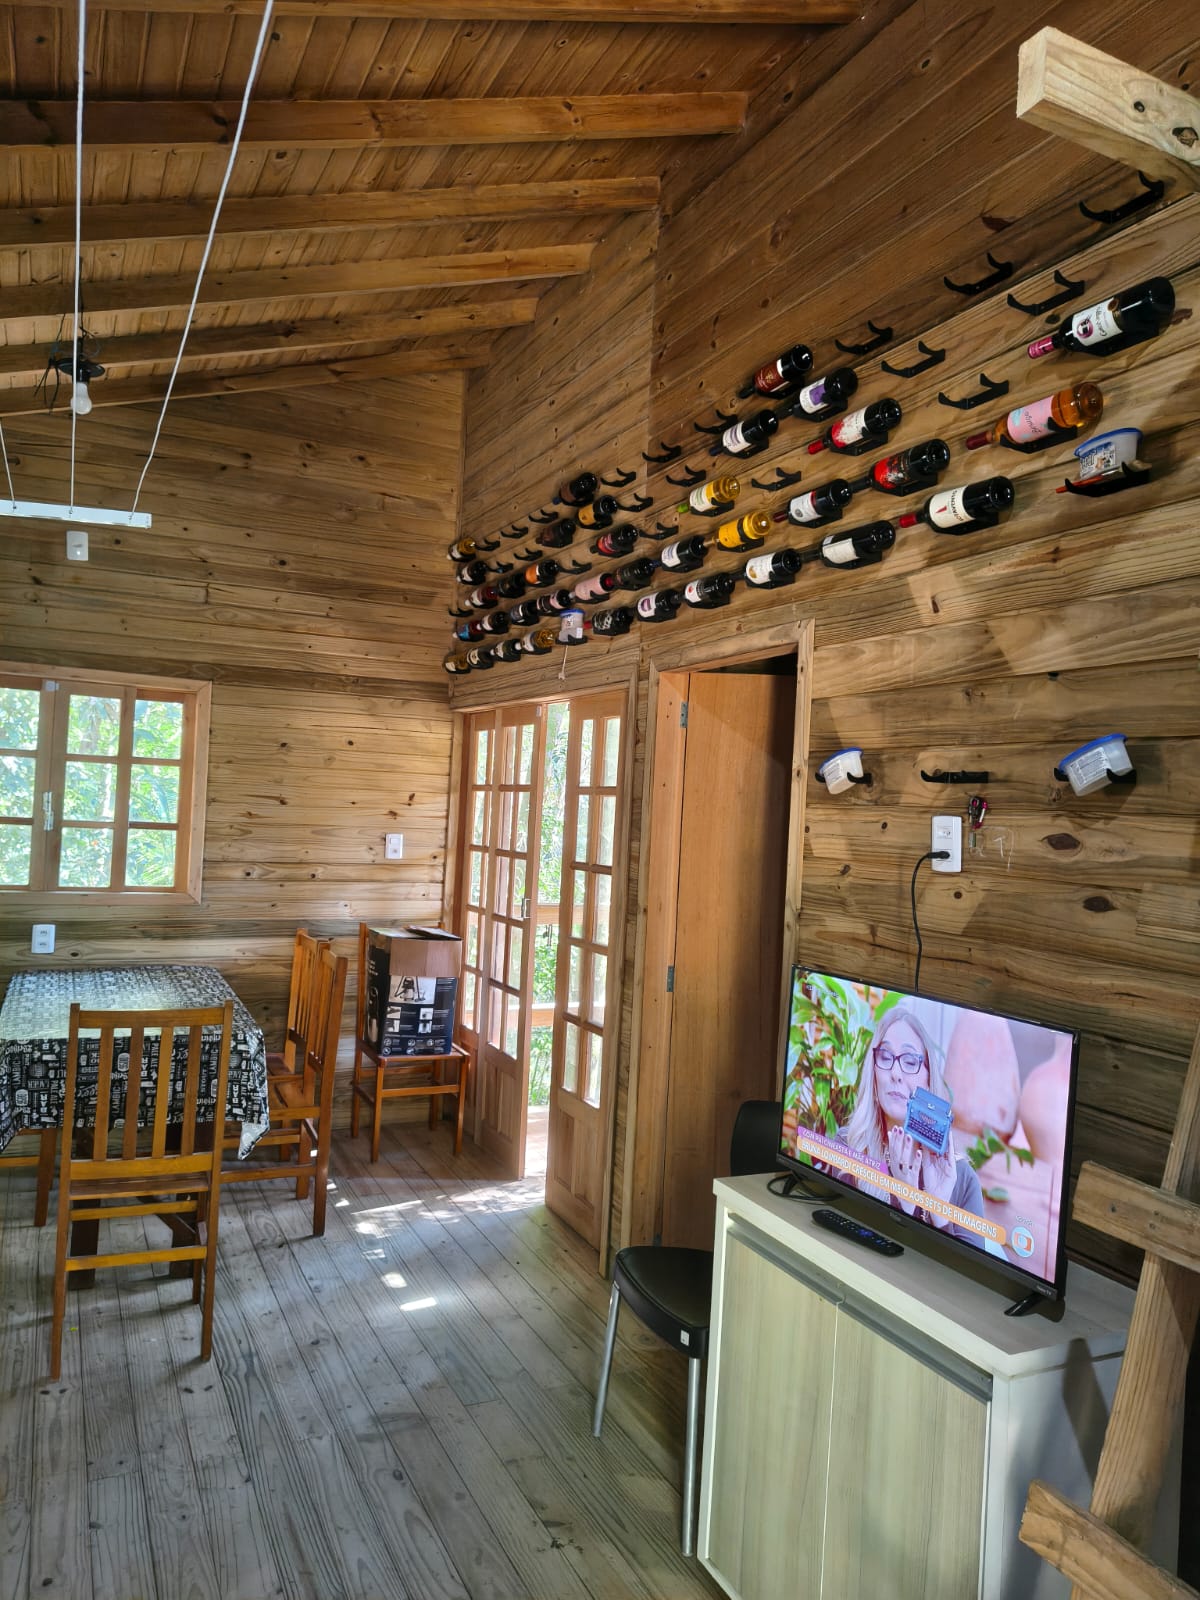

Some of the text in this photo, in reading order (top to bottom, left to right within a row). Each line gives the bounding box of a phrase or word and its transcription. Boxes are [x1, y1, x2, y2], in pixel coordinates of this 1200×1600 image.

[40, 1094, 48, 1113] BAR
[111, 1086, 121, 1113] LAMBIC
[852, 1163, 879, 1182] CRESCEU
[892, 1182, 908, 1197] MEIO
[909, 1190, 924, 1204] AOS
[924, 1196, 942, 1212] SETS
[942, 1204, 953, 1217] DE
[953, 1209, 998, 1238] FILMAGENS
